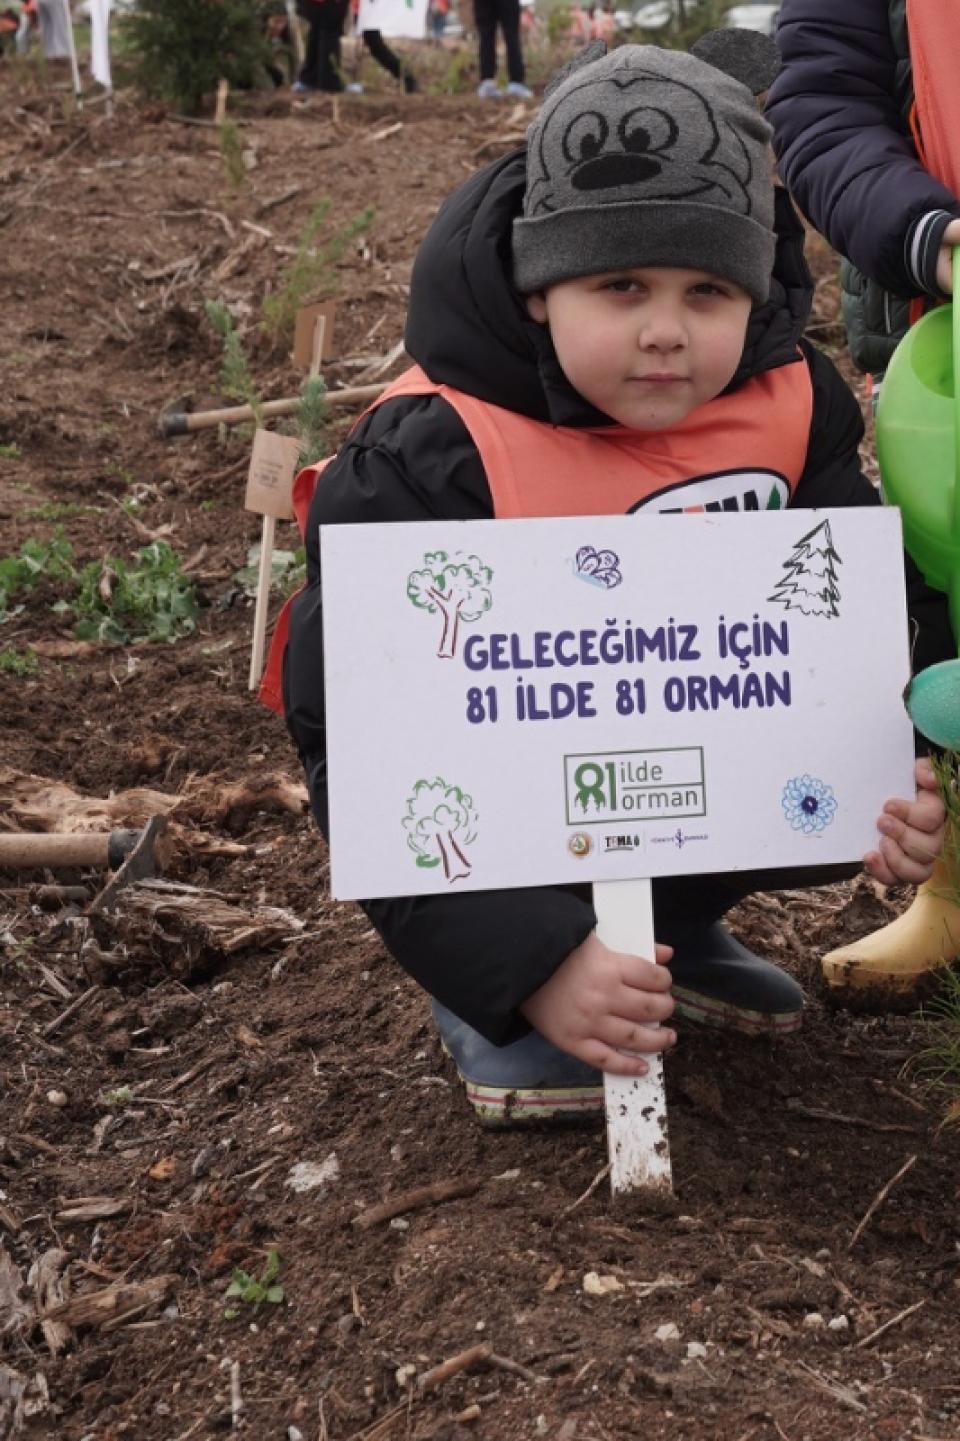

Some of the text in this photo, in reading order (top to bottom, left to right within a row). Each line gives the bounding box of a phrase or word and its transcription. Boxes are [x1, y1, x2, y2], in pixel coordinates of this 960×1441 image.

[463, 613, 790, 672] GELECEĞİMİZ İÇİN
[466, 670, 793, 724] 81 İLDE 81 ORMAN
[619, 760, 664, 783] ilde
[621, 789, 698, 810] orman
